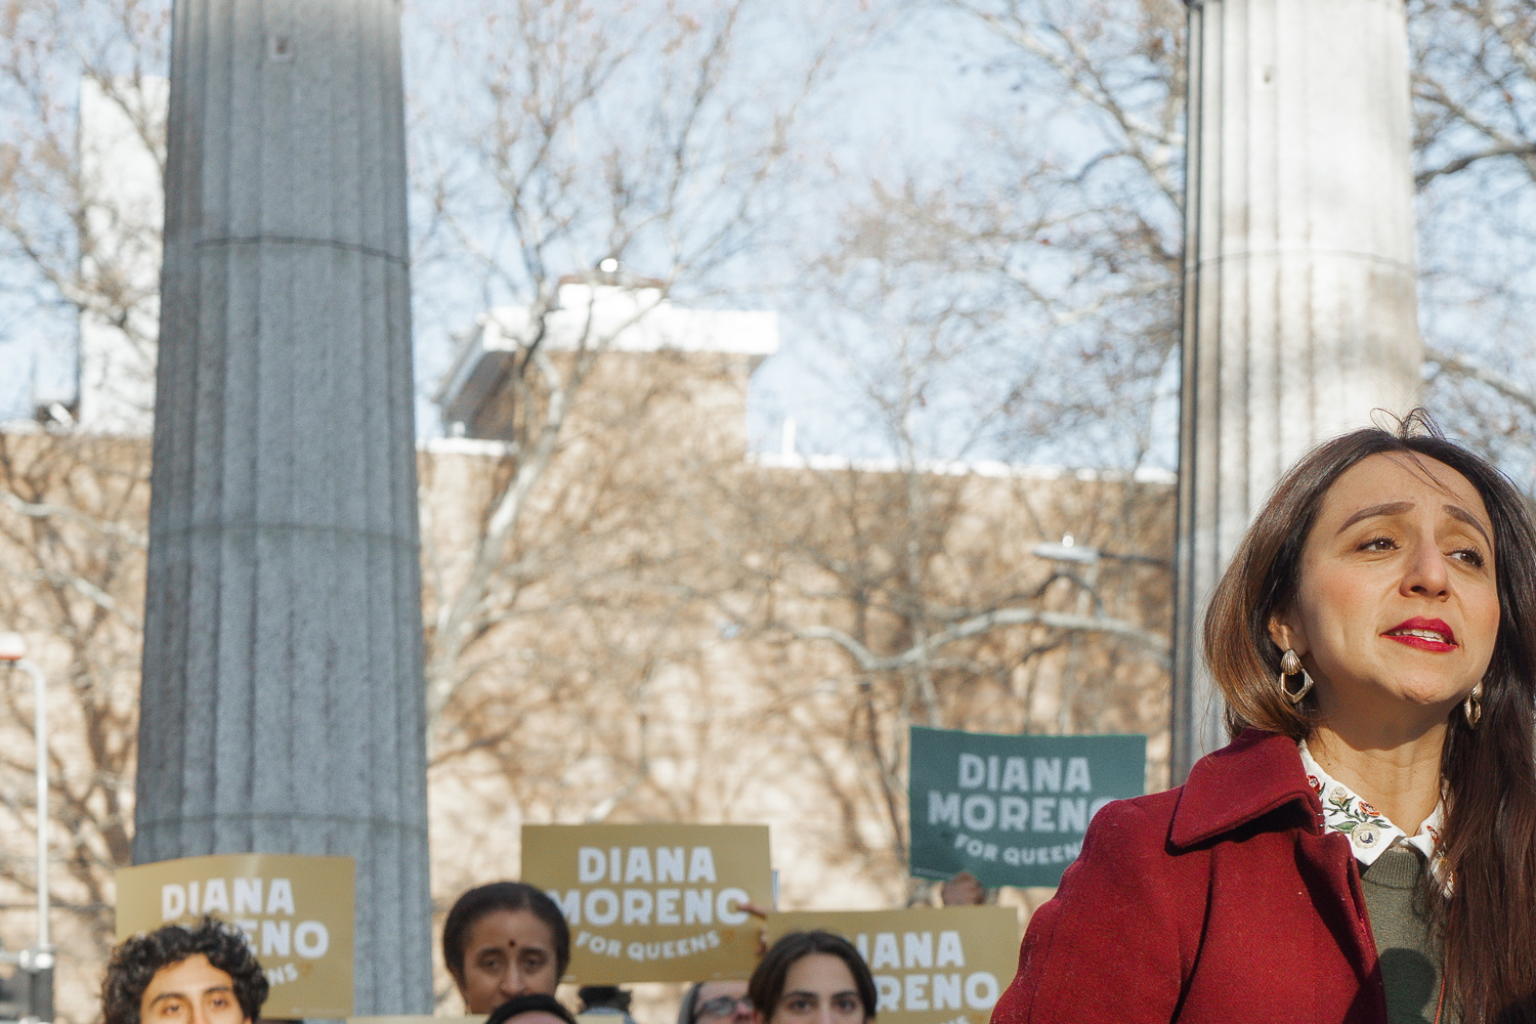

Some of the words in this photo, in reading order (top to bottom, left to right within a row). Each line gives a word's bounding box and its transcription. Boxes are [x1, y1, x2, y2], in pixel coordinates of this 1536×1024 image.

[958, 752, 1092, 793] DIANA
[927, 790, 1115, 833] MOREN
[578, 846, 717, 884] DIANA
[954, 834, 998, 862] FOR
[1003, 843, 1082, 867] QUEEN
[161, 876, 296, 921] DIANA
[545, 887, 750, 926] MORENO
[575, 930, 621, 958] FOR
[627, 930, 721, 963] QUEENS
[852, 930, 966, 969] IANA
[874, 971, 999, 1013] RENO
